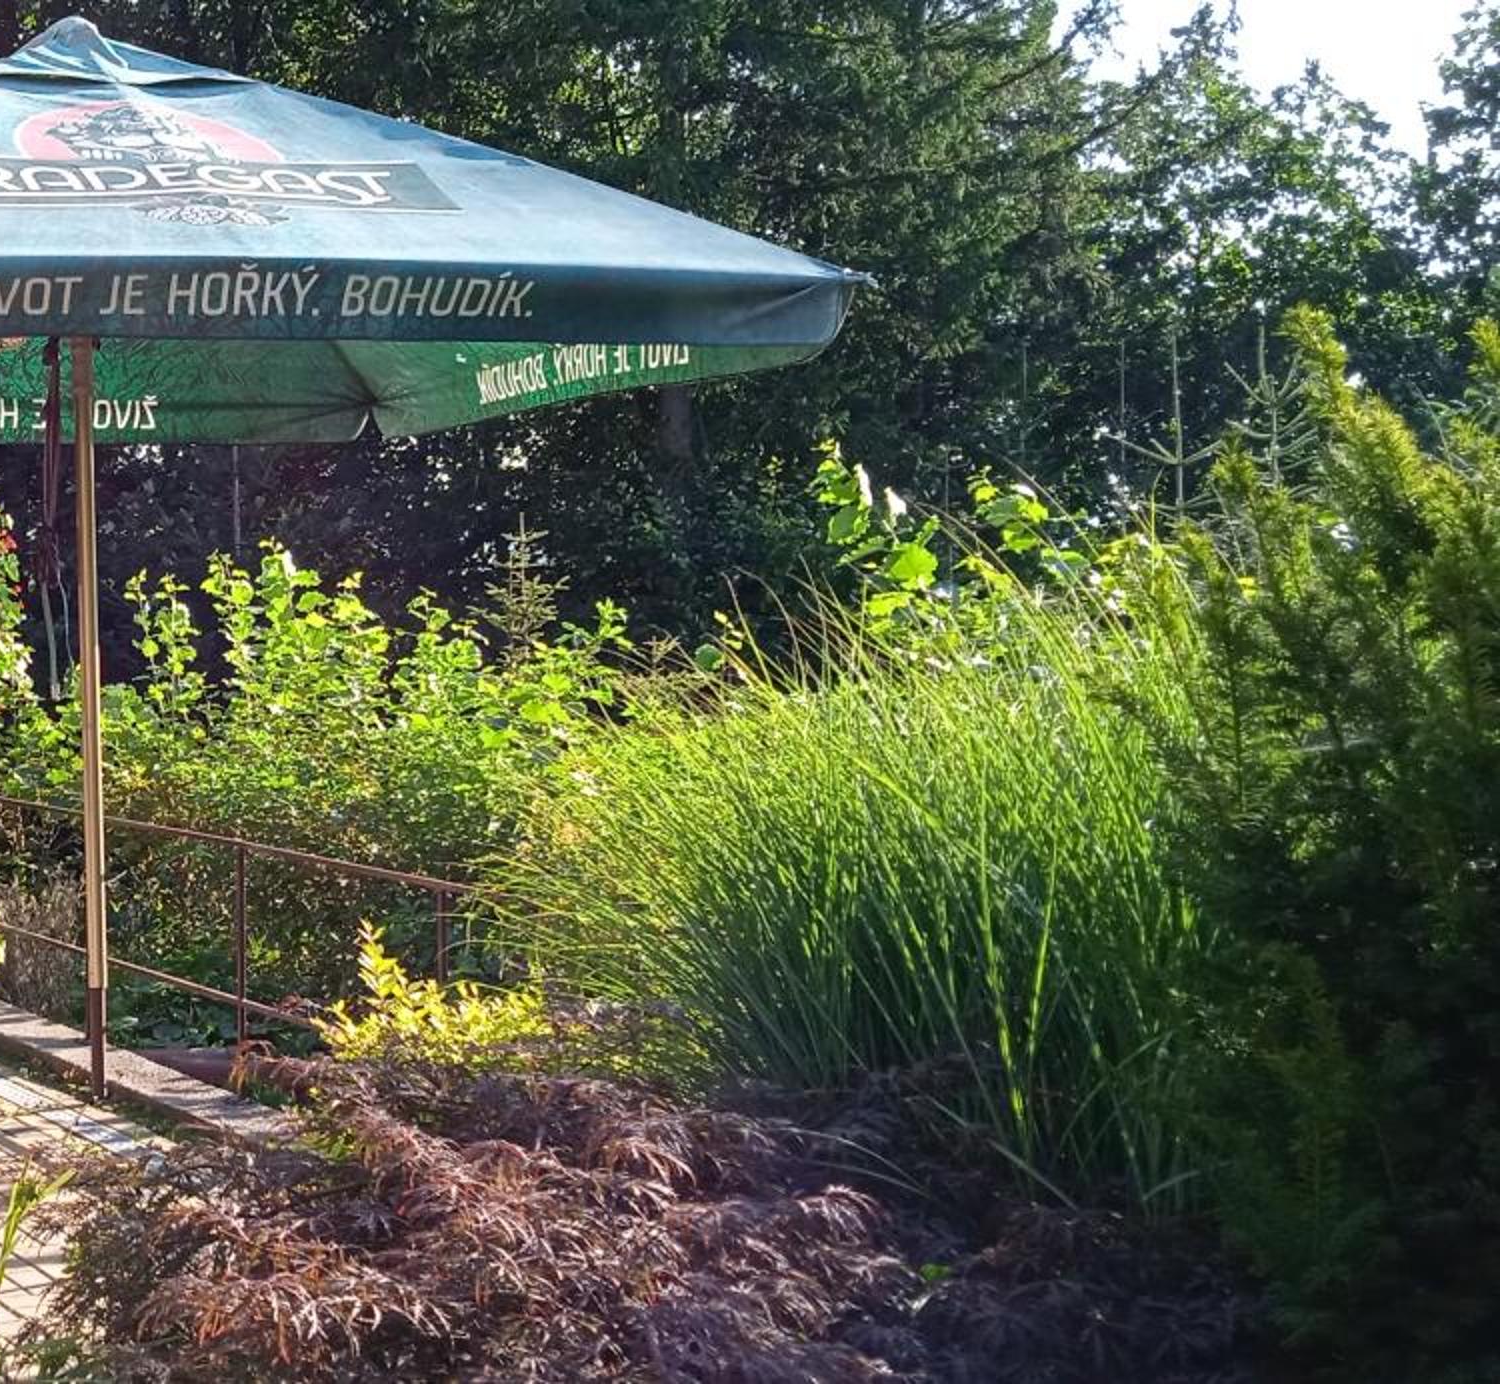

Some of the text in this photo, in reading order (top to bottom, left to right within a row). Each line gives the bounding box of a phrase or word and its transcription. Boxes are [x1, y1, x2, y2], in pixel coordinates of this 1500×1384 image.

[99, 273, 149, 316] JE
[166, 262, 320, 317] HOŘKÝ.
[341, 271, 535, 318] BOHUDÍK.
